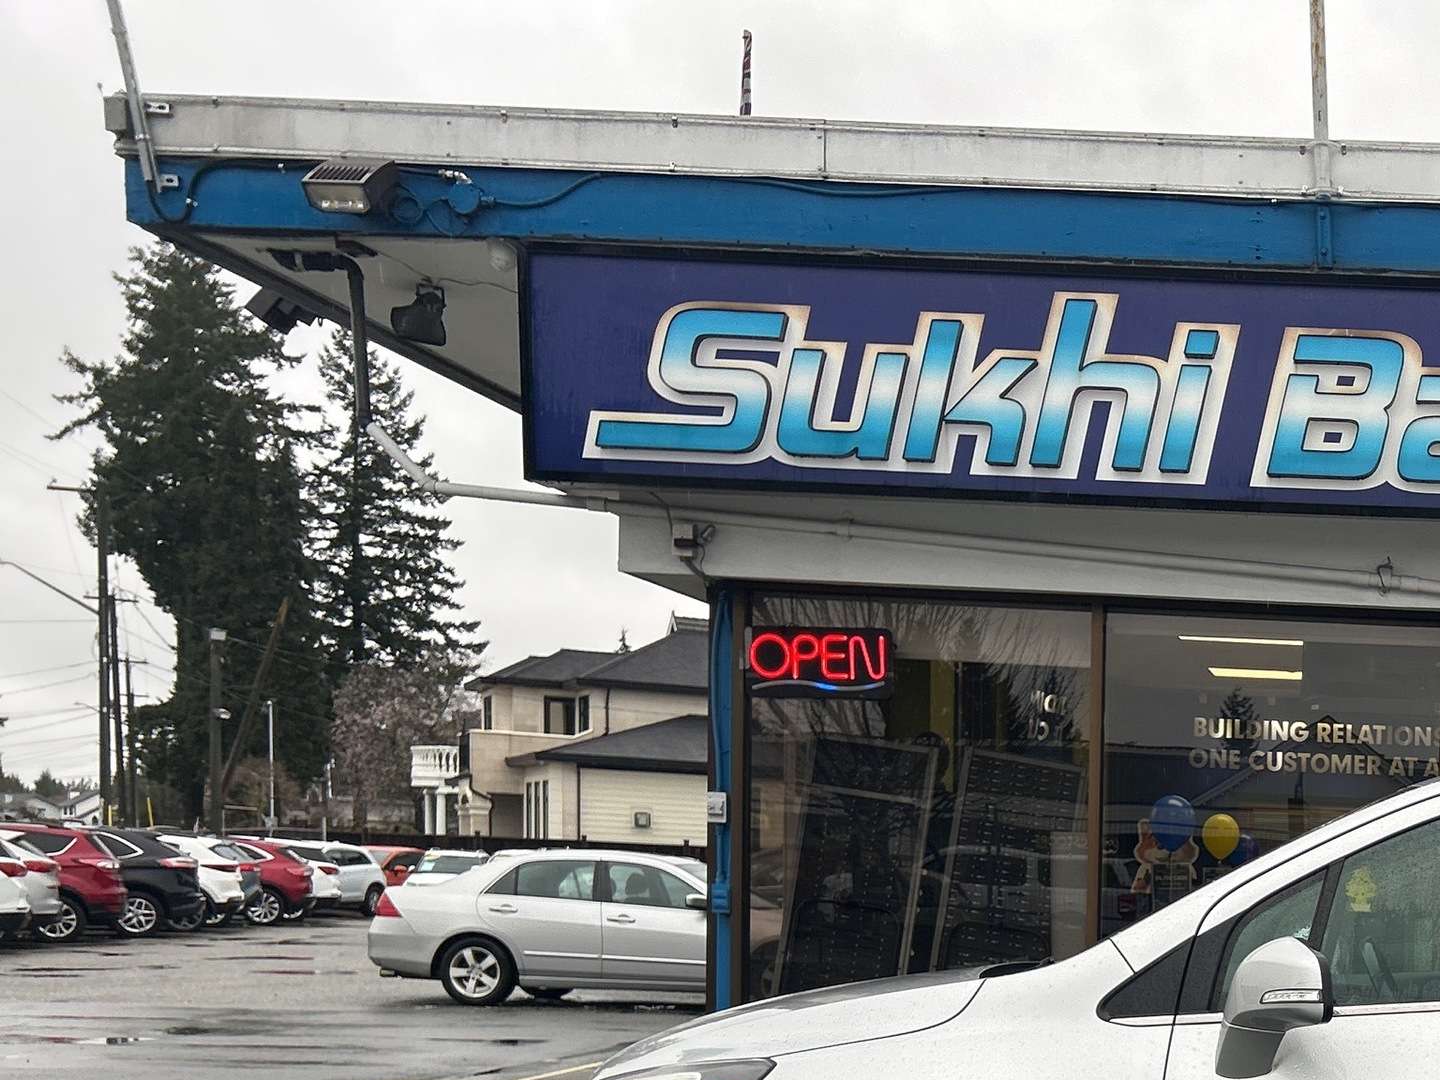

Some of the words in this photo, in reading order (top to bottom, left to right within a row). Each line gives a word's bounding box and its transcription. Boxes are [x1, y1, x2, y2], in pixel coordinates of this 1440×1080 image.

[583, 291, 1241, 485] Sukhi
[750, 632, 888, 681] OPEN
[1193, 717, 1310, 742] BUILDING
[1188, 748, 1240, 770] ONE
[1248, 750, 1381, 776] CUSTOMER
[1389, 756, 1418, 777] AT
[1423, 757, 1440, 777] A
